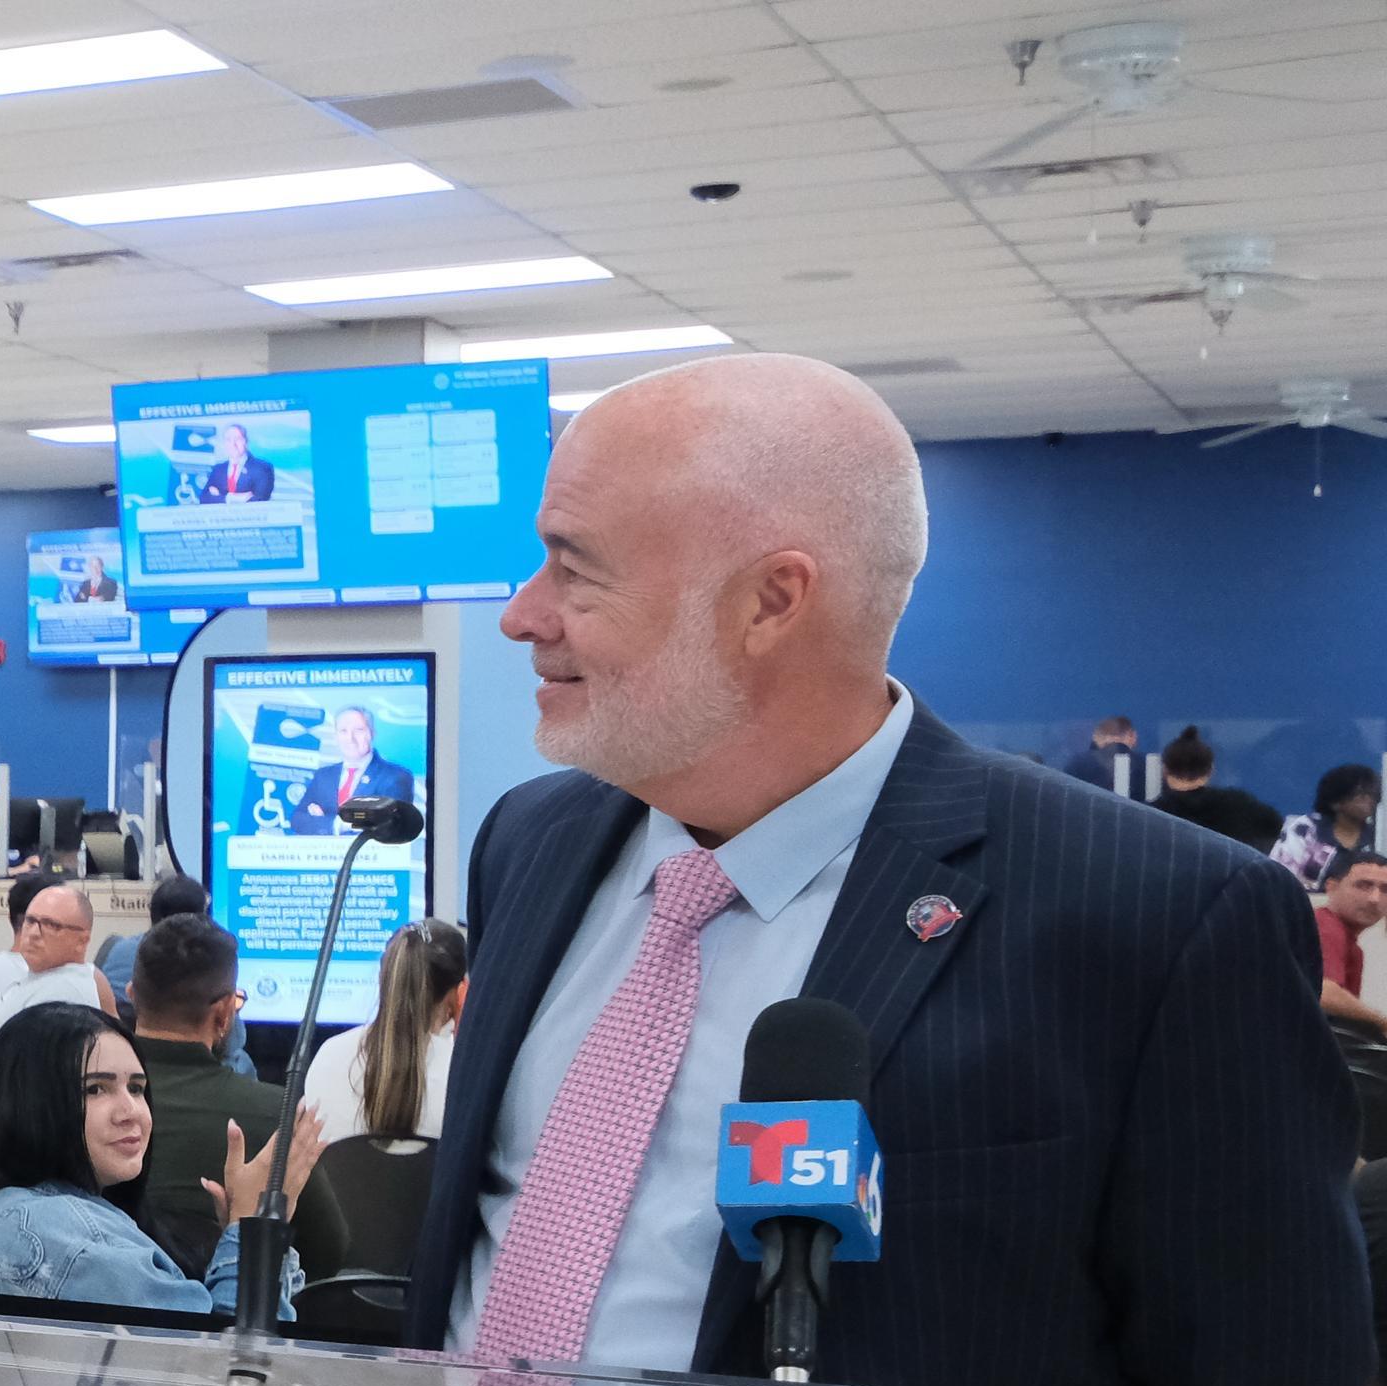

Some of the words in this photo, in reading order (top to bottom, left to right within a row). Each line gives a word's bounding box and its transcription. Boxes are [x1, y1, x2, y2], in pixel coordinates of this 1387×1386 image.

[228, 671, 307, 686] EFFECTIVE
[310, 668, 415, 683] IMMEDIATELY
[788, 1149, 850, 1186] 51
